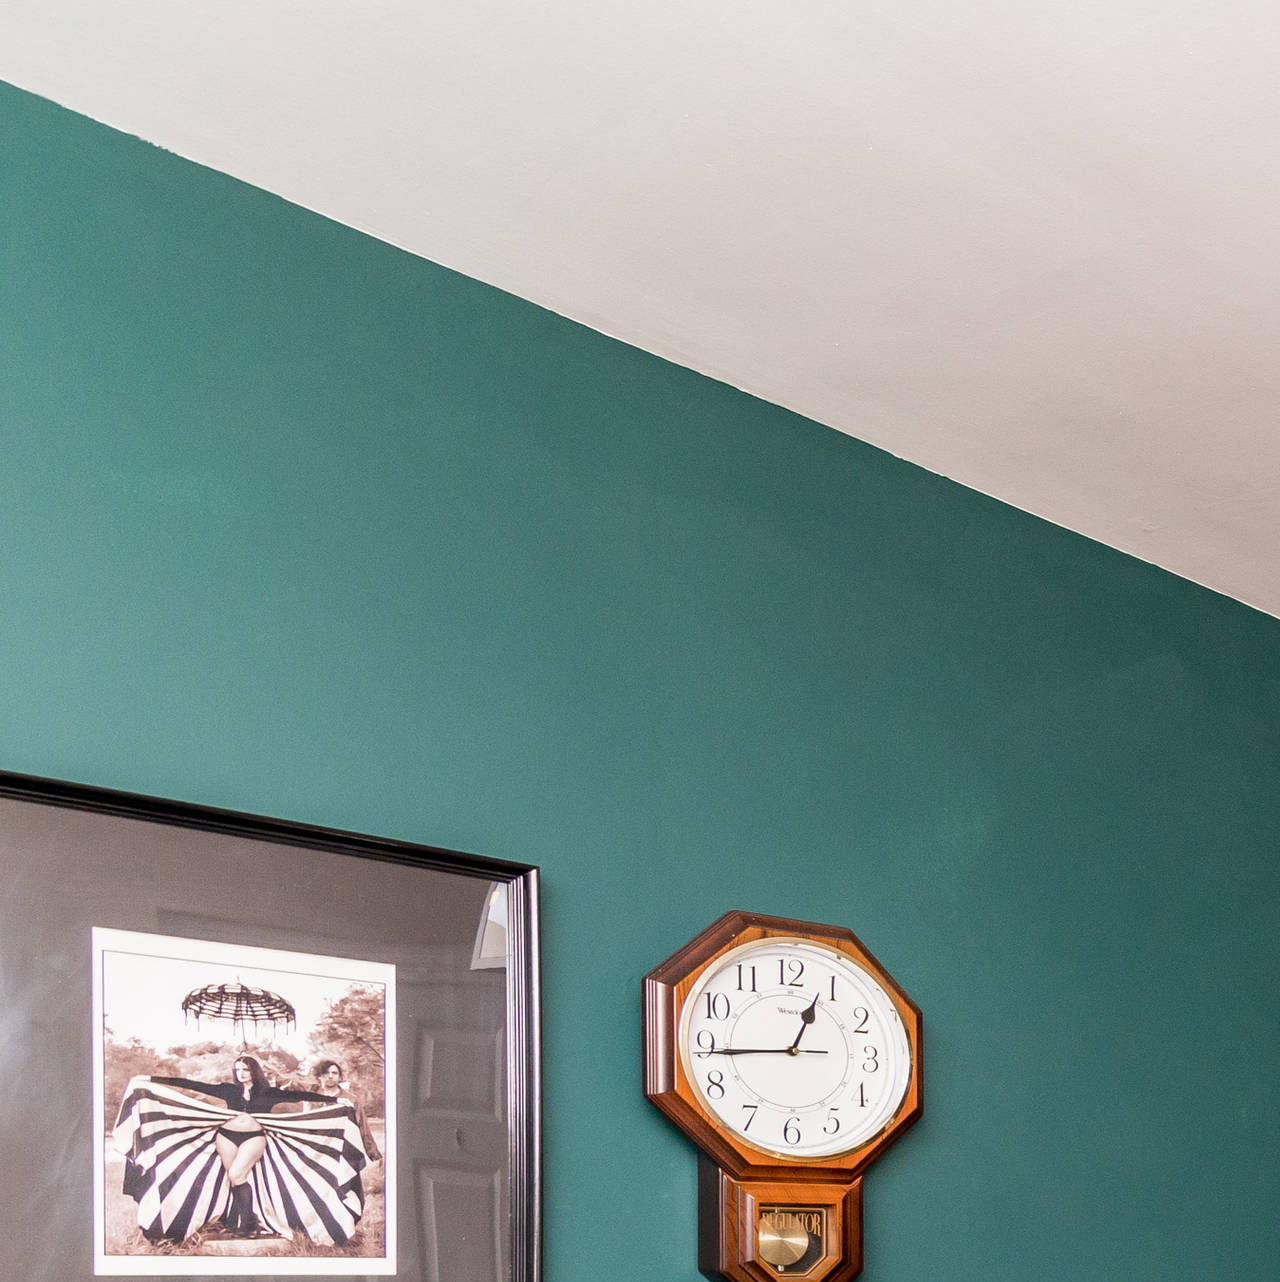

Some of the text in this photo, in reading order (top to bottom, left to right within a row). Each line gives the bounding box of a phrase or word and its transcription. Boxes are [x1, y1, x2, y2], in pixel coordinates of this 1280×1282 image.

[737, 963, 757, 992] 11
[778, 959, 804, 987] 12
[829, 975, 837, 1001] 1
[705, 992, 730, 1021] 10
[853, 1007, 869, 1034] 2
[697, 1030, 715, 1059] 9
[862, 1046, 879, 1073] 3
[707, 1070, 725, 1100] 8
[851, 1081, 869, 1107] 4
[742, 1105, 758, 1131] 7
[784, 1117, 801, 1145] 6
[823, 1107, 840, 1135] 5
